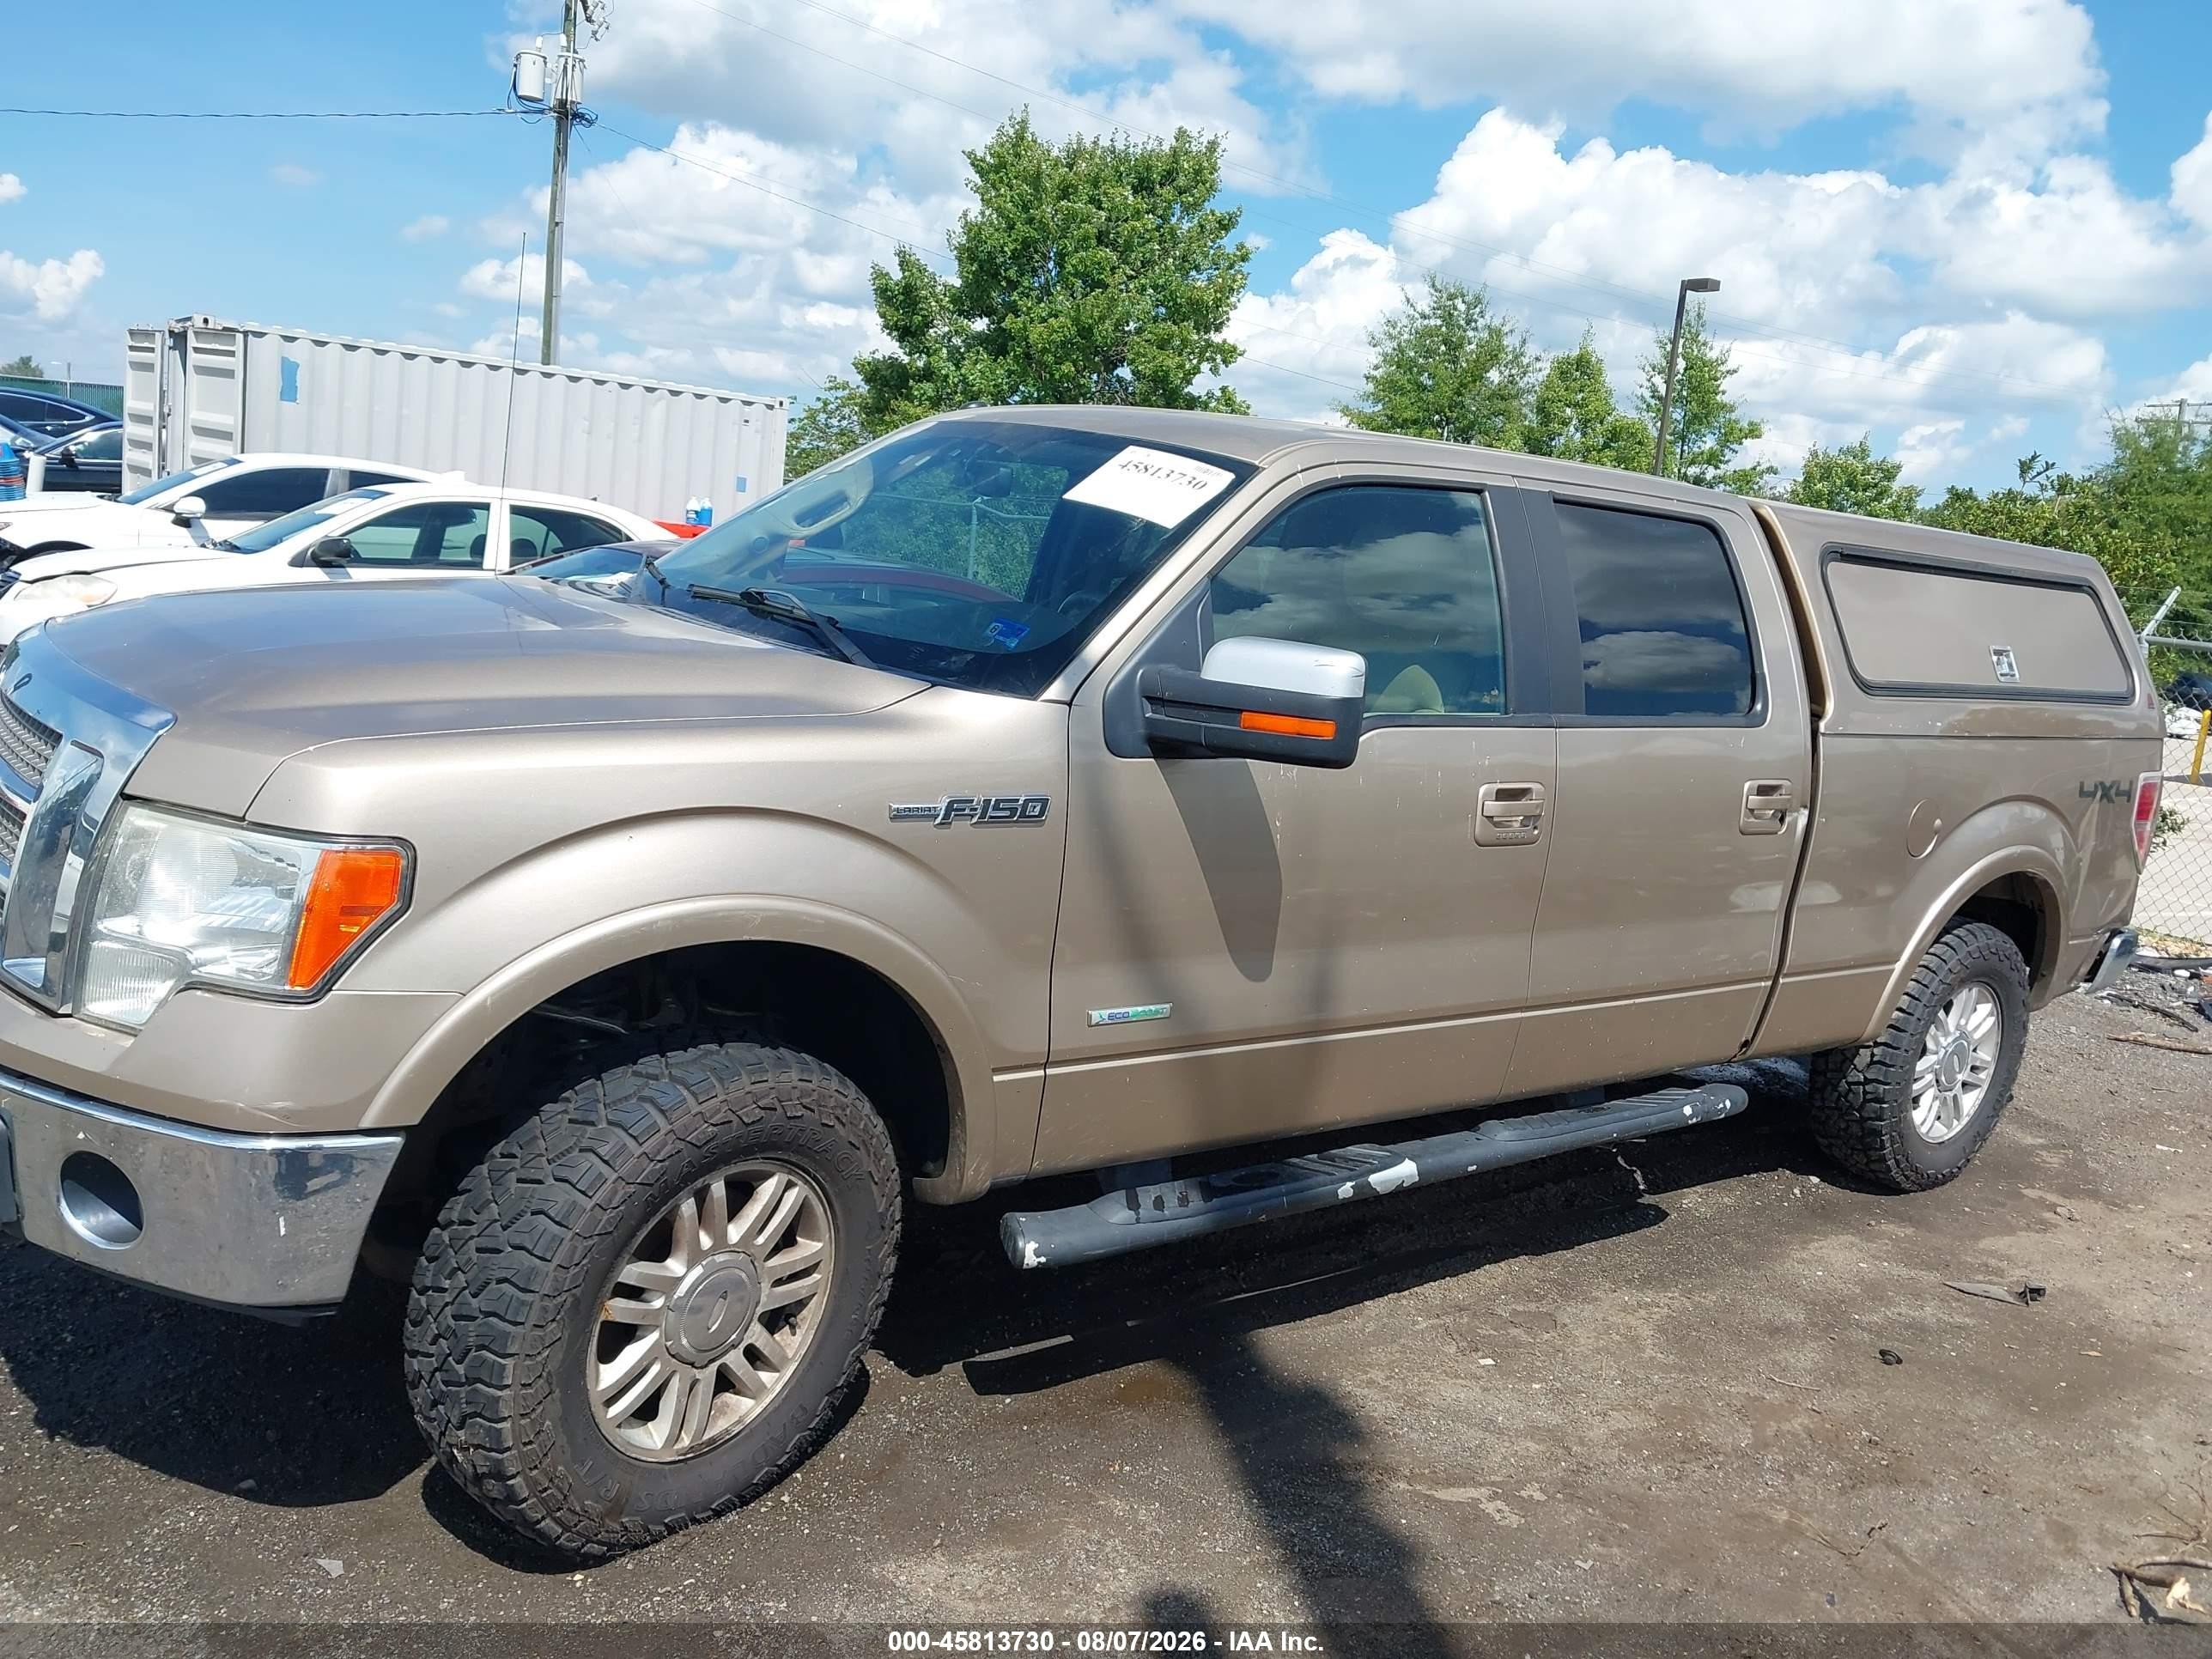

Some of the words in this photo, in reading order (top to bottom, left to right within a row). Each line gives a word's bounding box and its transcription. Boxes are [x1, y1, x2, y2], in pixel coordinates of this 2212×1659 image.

[1118, 459, 1208, 491] 45813730
[895, 805, 939, 815] LARIAT
[935, 795, 1052, 824] F-150
